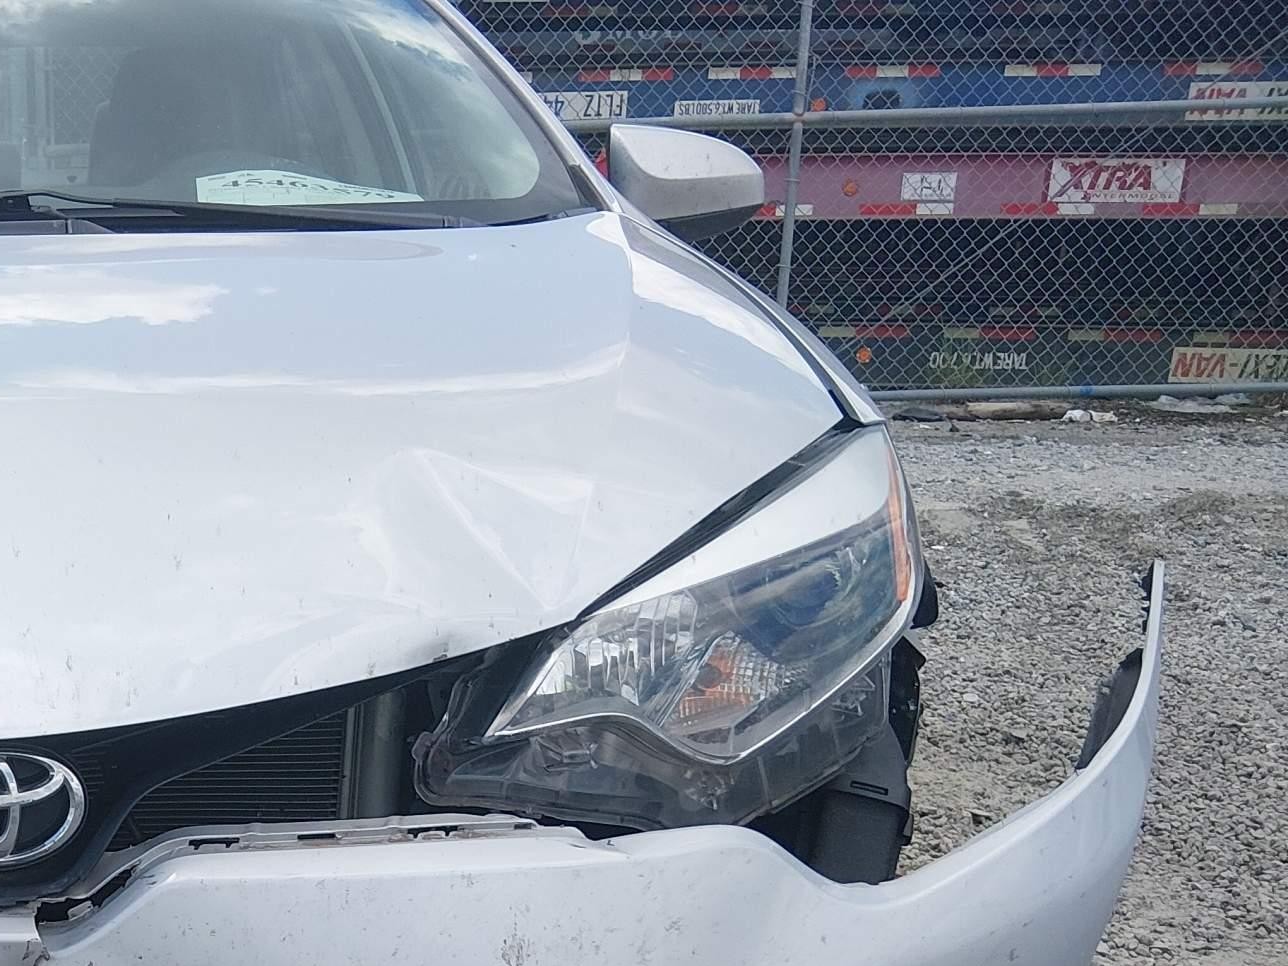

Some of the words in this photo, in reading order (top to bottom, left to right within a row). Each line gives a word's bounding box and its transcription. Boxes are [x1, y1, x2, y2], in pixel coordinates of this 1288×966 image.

[583, 94, 624, 117] FLTZ
[735, 102, 756, 115] TARE
[1055, 161, 1152, 196] XTRA
